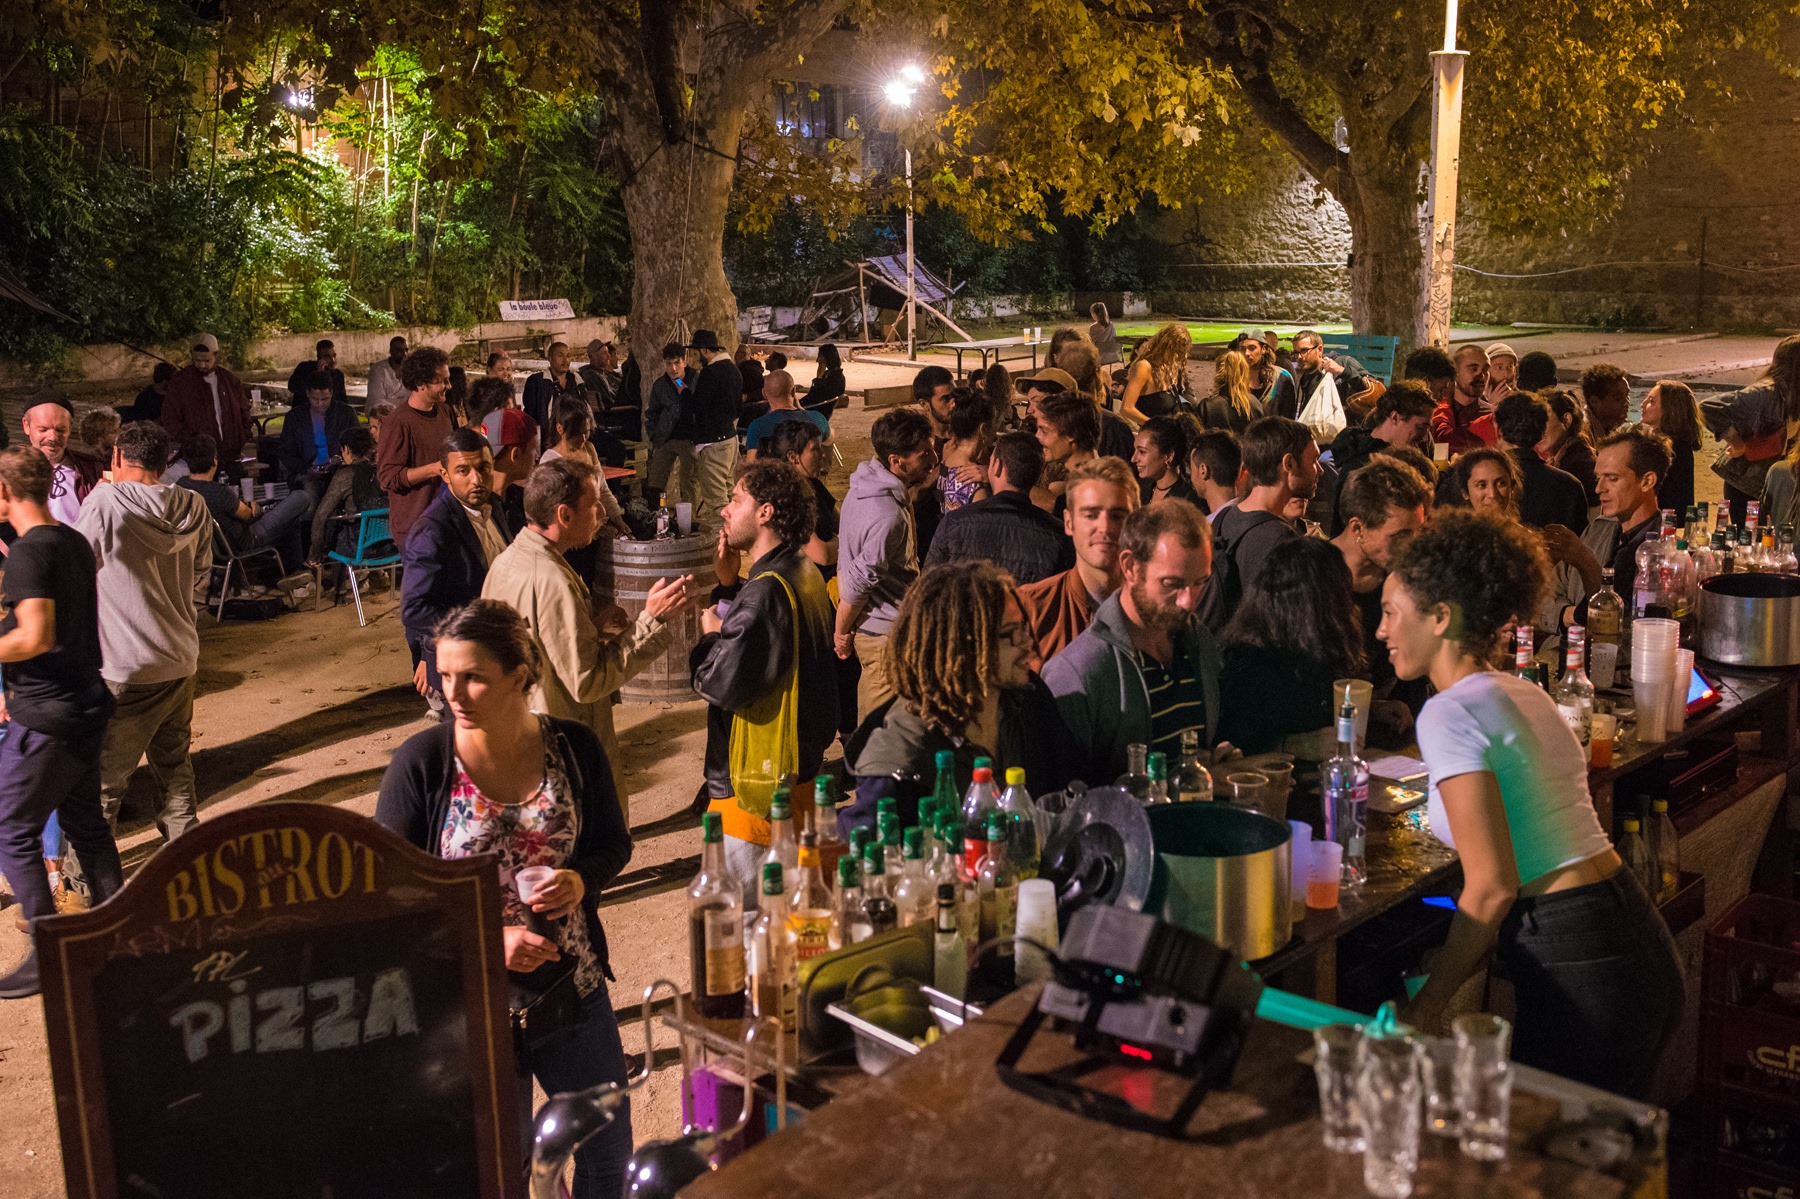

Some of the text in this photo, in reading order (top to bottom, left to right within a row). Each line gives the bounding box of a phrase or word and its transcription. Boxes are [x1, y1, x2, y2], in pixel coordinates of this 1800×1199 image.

[509, 301, 558, 311] la boule bleue
[1563, 714, 1590, 723] ONIN
[165, 827, 384, 922] BISTROT
